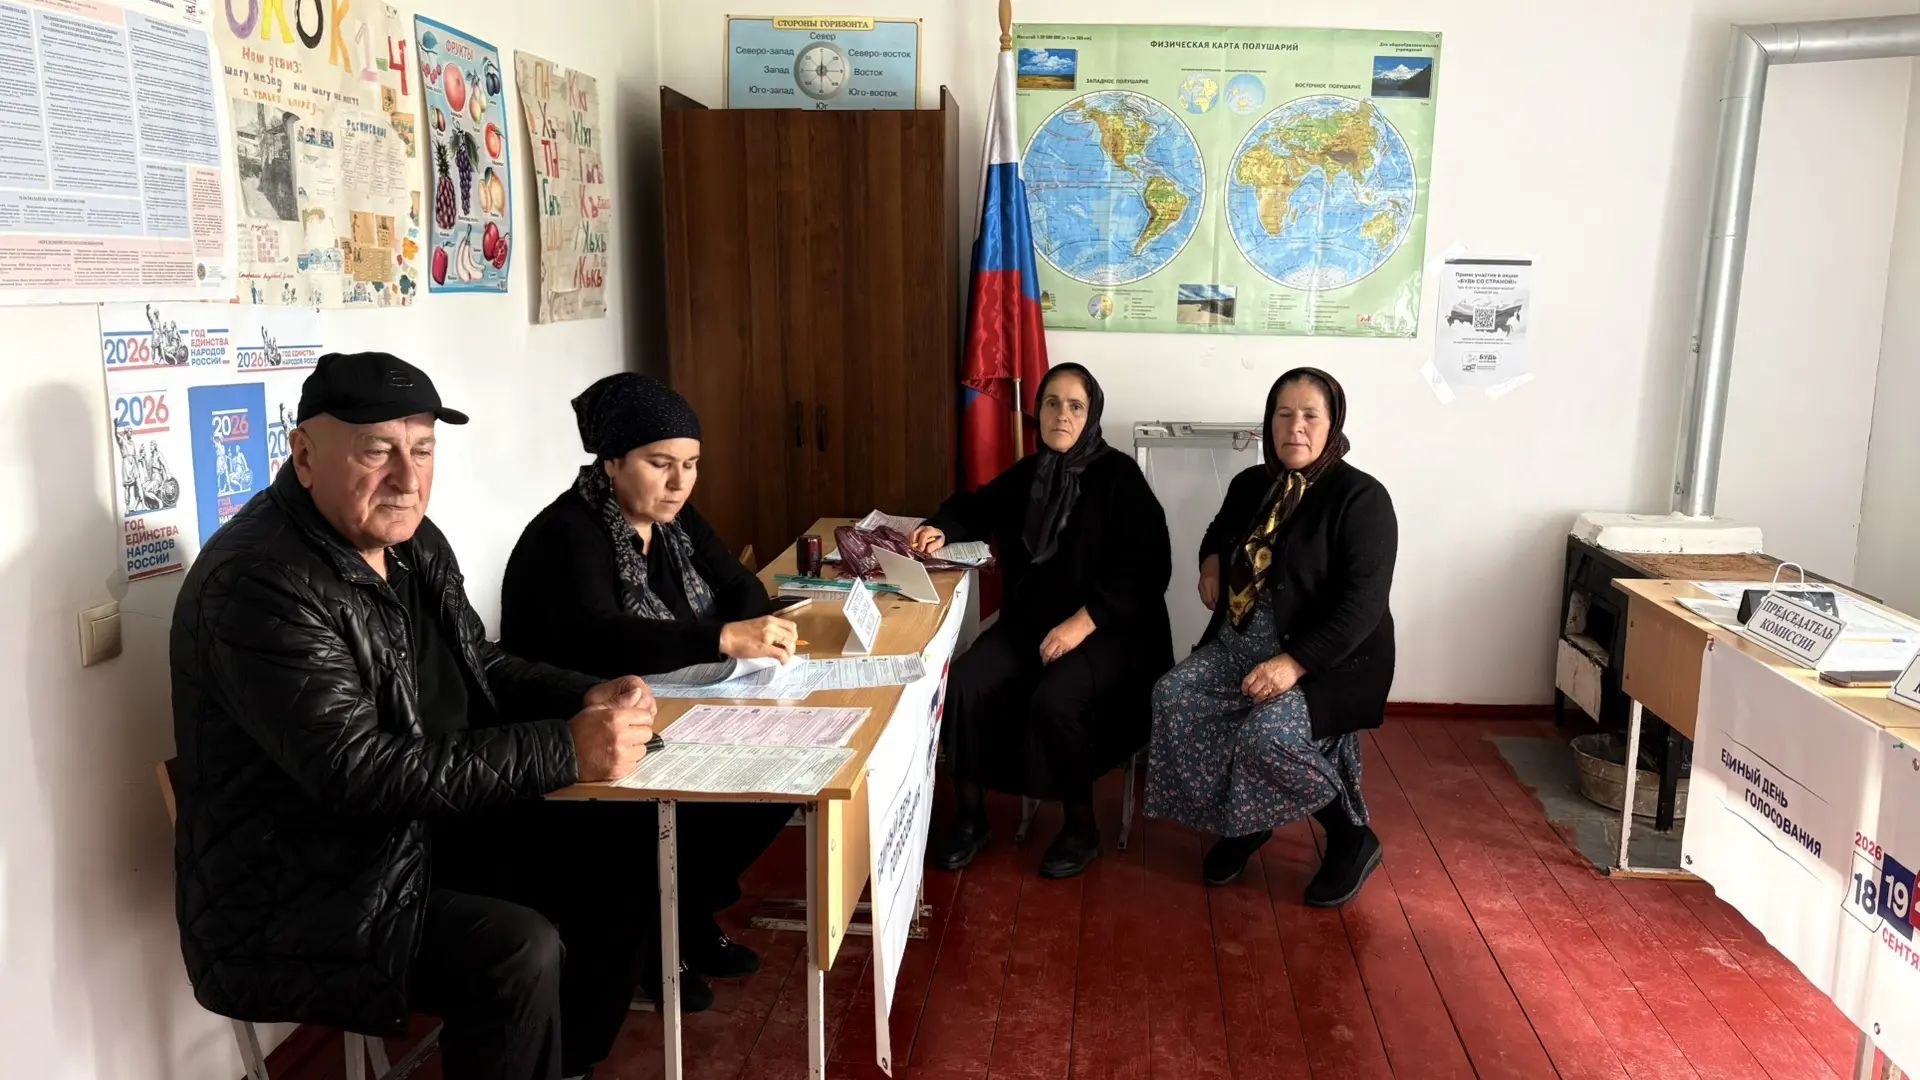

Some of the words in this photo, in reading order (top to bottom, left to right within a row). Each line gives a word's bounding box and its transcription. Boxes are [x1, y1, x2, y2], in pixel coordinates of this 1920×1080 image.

[777, 20, 818, 28] СТОРОНЫ
[820, 20, 869, 29] ГОРИЗОНТА
[809, 32, 836, 41] Север
[1150, 40, 1210, 49] ФИЗИЧЕСКАЯ
[1212, 41, 1240, 50] КАРТА
[1242, 42, 1299, 51] ПОЛУШАРИЙ
[242, 46, 265, 65] Наш
[446, 40, 473, 60] ФРУКТЫ
[735, 46, 795, 57] Северо-запад
[848, 49, 911, 58] Северо-восток
[764, 66, 790, 74] Запад
[854, 68, 883, 77] Восток
[253, 71, 282, 93] назад
[749, 86, 795, 96] Юго-запад
[849, 88, 898, 97] Юго-восток
[816, 102, 828, 110] Юг
[190, 328, 206, 338] ГОД
[104, 337, 150, 365] 2026
[190, 337, 229, 348] ЕДИНСТВА
[190, 347, 226, 356] НАРОДОВ
[191, 356, 222, 366] РОССИИ
[236, 351, 264, 368] 2026
[115, 394, 170, 428] 2026
[211, 413, 249, 438] 2026
[268, 429, 288, 459] 20
[124, 518, 146, 533] ГОД
[125, 525, 179, 546] ЕДИНСТВА
[126, 538, 175, 559] НАРОДОВ
[127, 552, 170, 572] РОССИИ
[1762, 600, 1835, 641] ПРЕДСЕДАТЕЛЬ
[1759, 617, 1817, 652] КОМИССИИ
[1720, 748, 1762, 789] ЕДИНЫЙ
[1762, 780, 1788, 809] ДЕНЬ
[1744, 787, 1823, 859] ГОЛОСОВАНИЯ
[1855, 831, 1883, 862] 2026
[1854, 872, 1878, 915] 18
[1885, 875, 1909, 918] 19
[1882, 926, 1920, 972] СЕНТЯ
